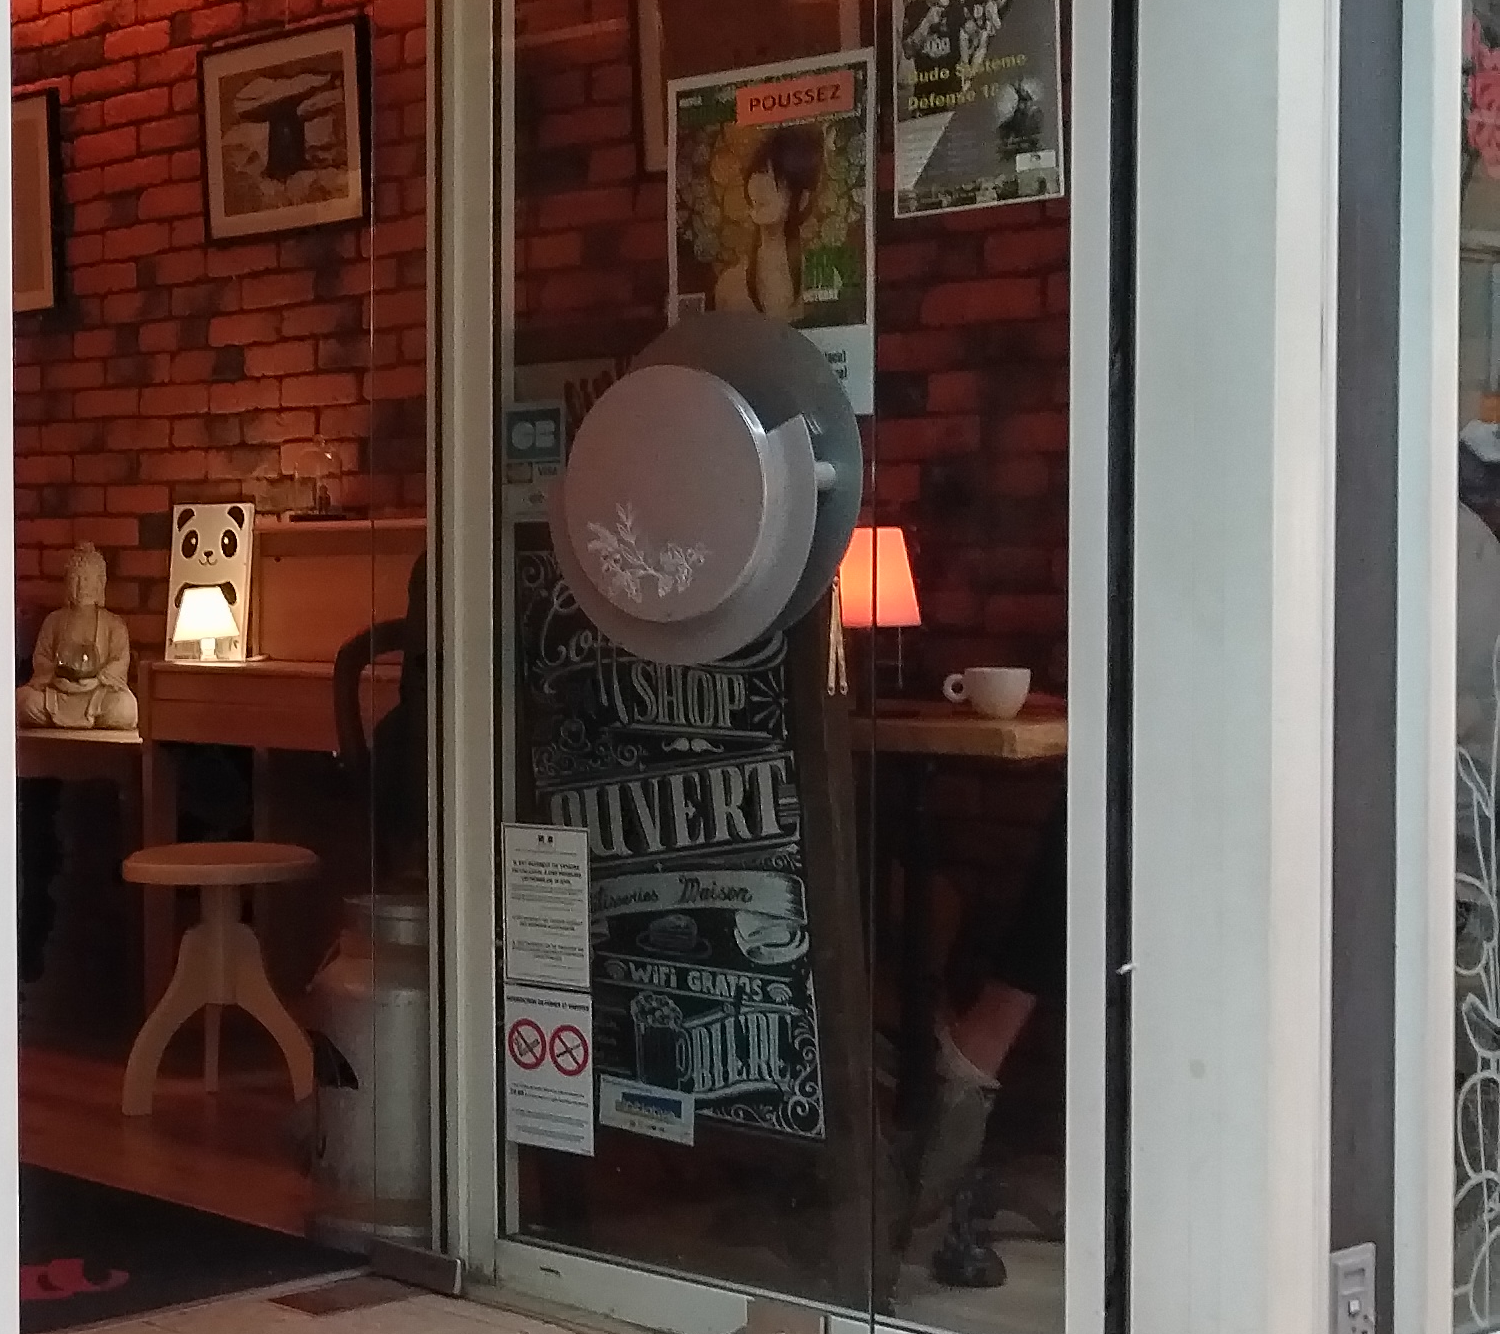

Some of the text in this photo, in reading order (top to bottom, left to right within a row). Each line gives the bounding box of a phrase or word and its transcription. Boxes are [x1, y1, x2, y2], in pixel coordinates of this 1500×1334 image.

[749, 83, 841, 113] POUSSEZ
[630, 662, 746, 728] SHOP
[550, 758, 789, 857] OUVERT
[677, 874, 754, 906] Maison
